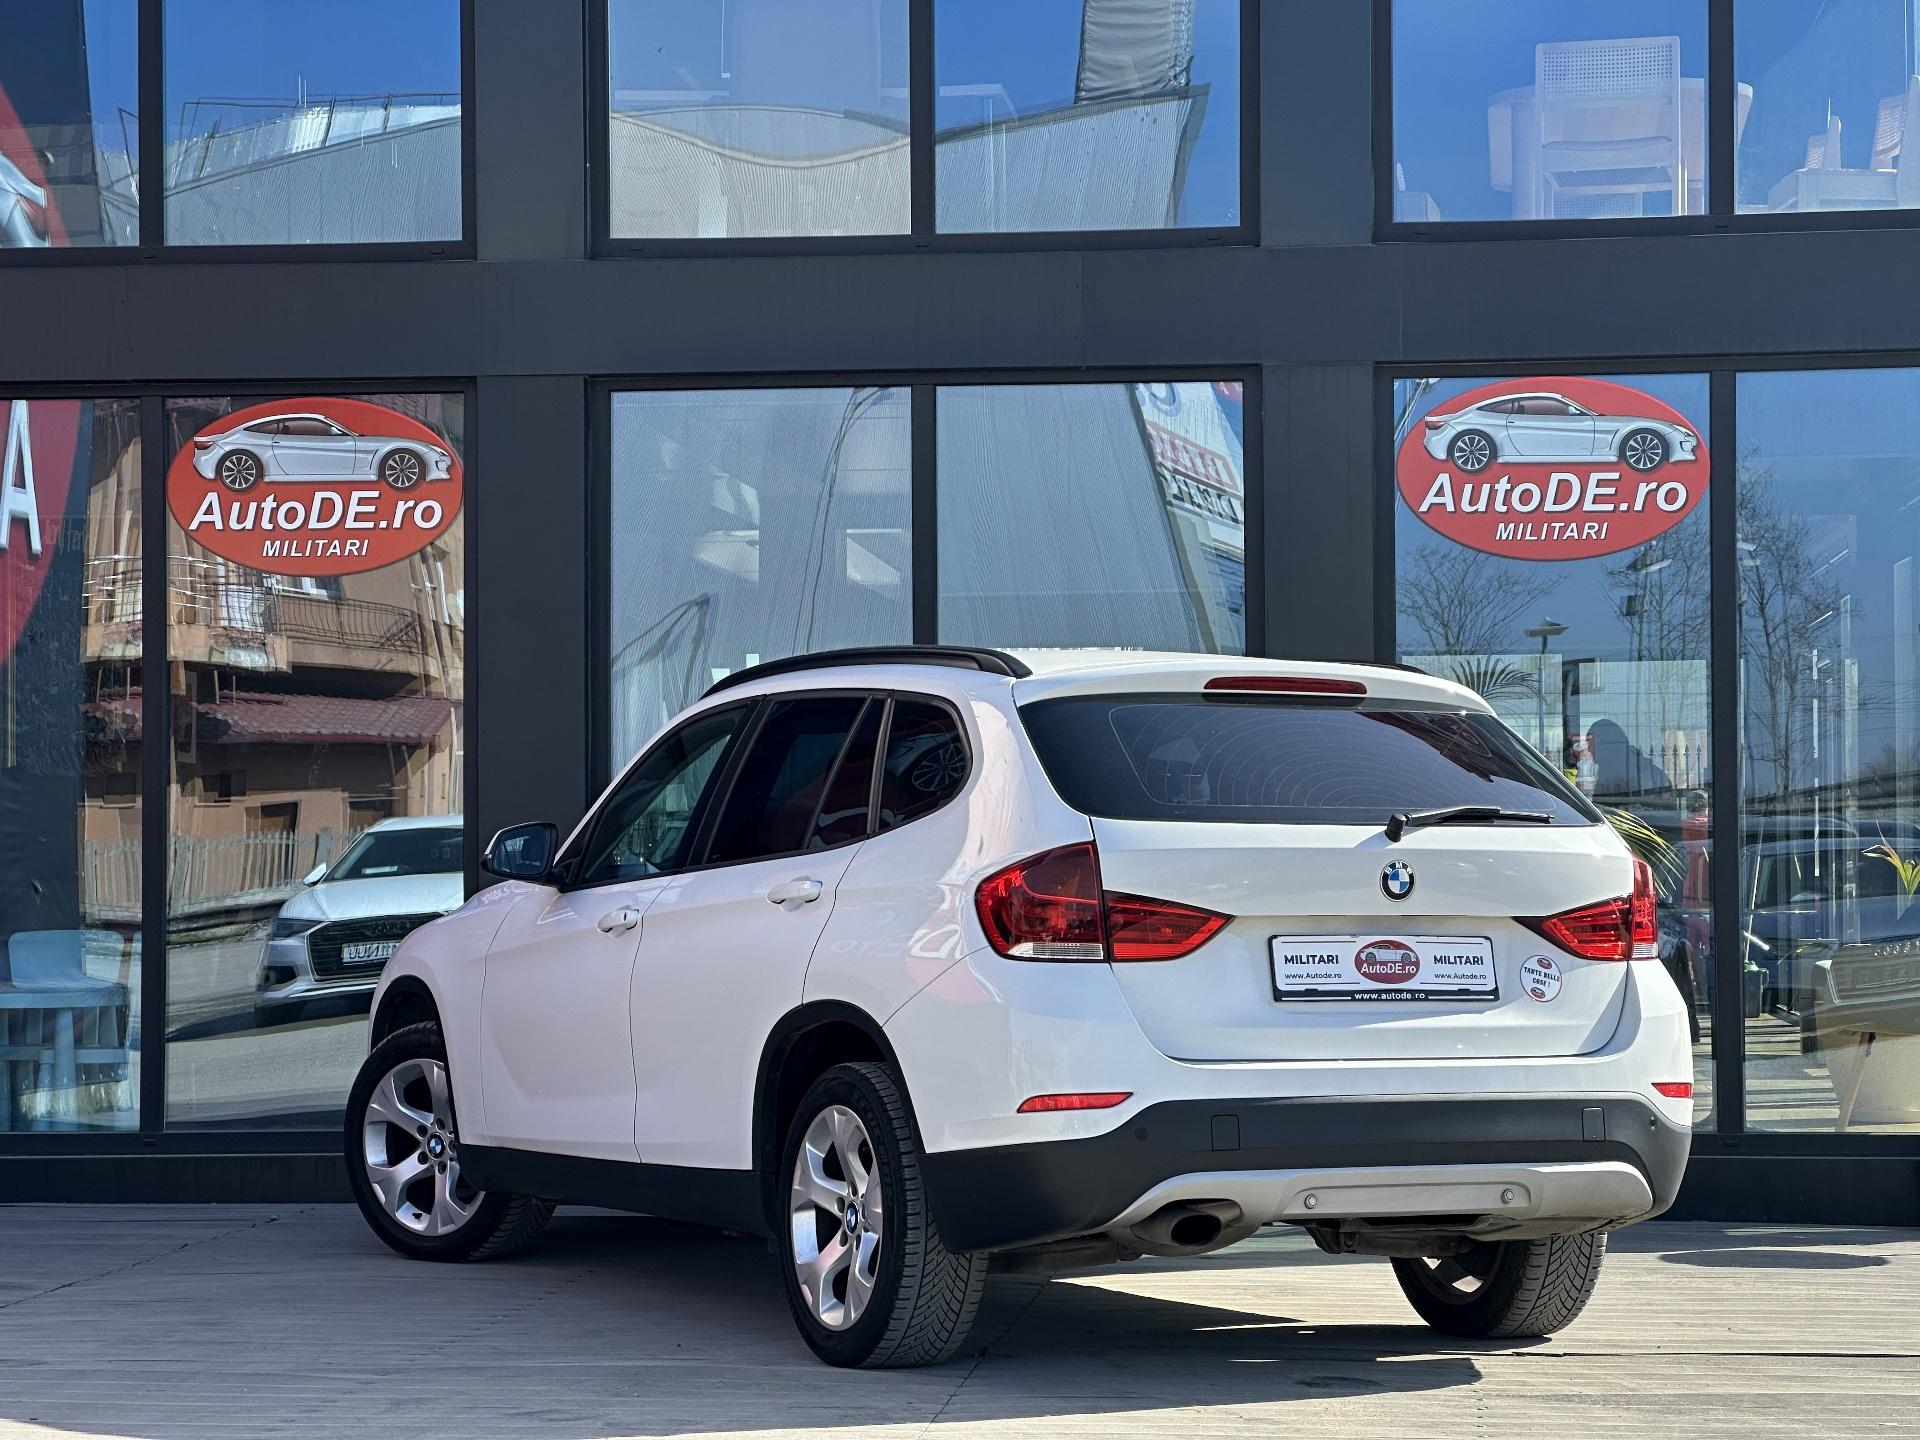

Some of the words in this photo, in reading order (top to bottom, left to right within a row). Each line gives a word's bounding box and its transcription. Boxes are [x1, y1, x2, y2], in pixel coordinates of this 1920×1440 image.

[1418, 472, 1688, 513] AutoDE.ro
[188, 490, 443, 531] AutoDE.ro
[1495, 522, 1608, 540] MILITARI
[262, 539, 369, 557] MILITARI
[1284, 954, 1340, 965] MILITARI
[1433, 954, 1484, 966] MILITARI
[1360, 962, 1417, 974] AutoDE.ro
[1524, 966, 1542, 976] TANTE
[1544, 972, 1560, 982] BELLE
[1284, 972, 1342, 980] www.Autode.ro
[1532, 977, 1547, 986] COSE
[1354, 991, 1426, 1000] www.autode.ro
